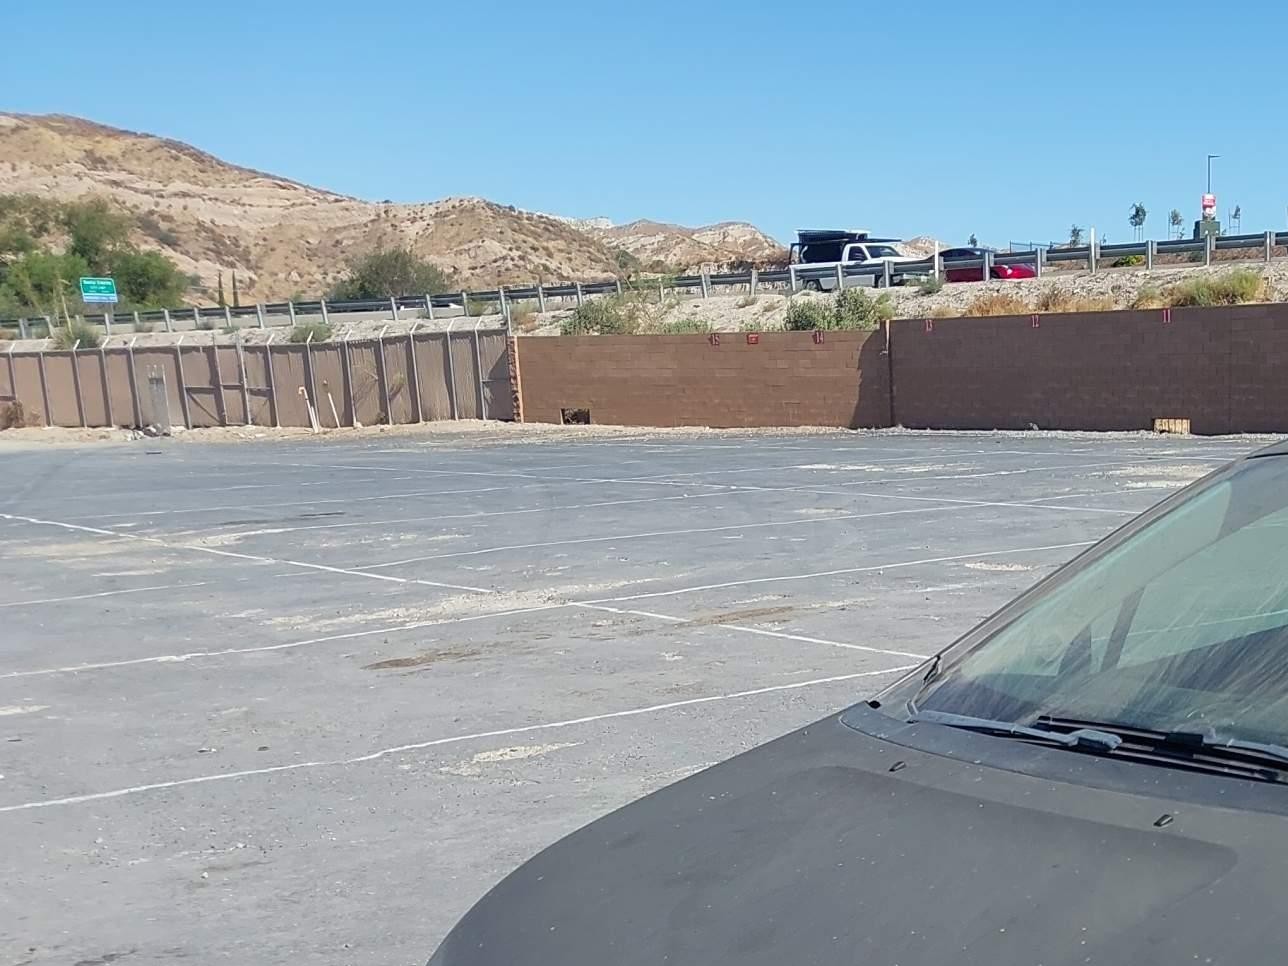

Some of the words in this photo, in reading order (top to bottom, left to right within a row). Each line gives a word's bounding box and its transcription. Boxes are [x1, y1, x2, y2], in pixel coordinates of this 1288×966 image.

[1031, 314, 1040, 328] 12
[1163, 309, 1171, 323] 11
[925, 319, 933, 332] 13
